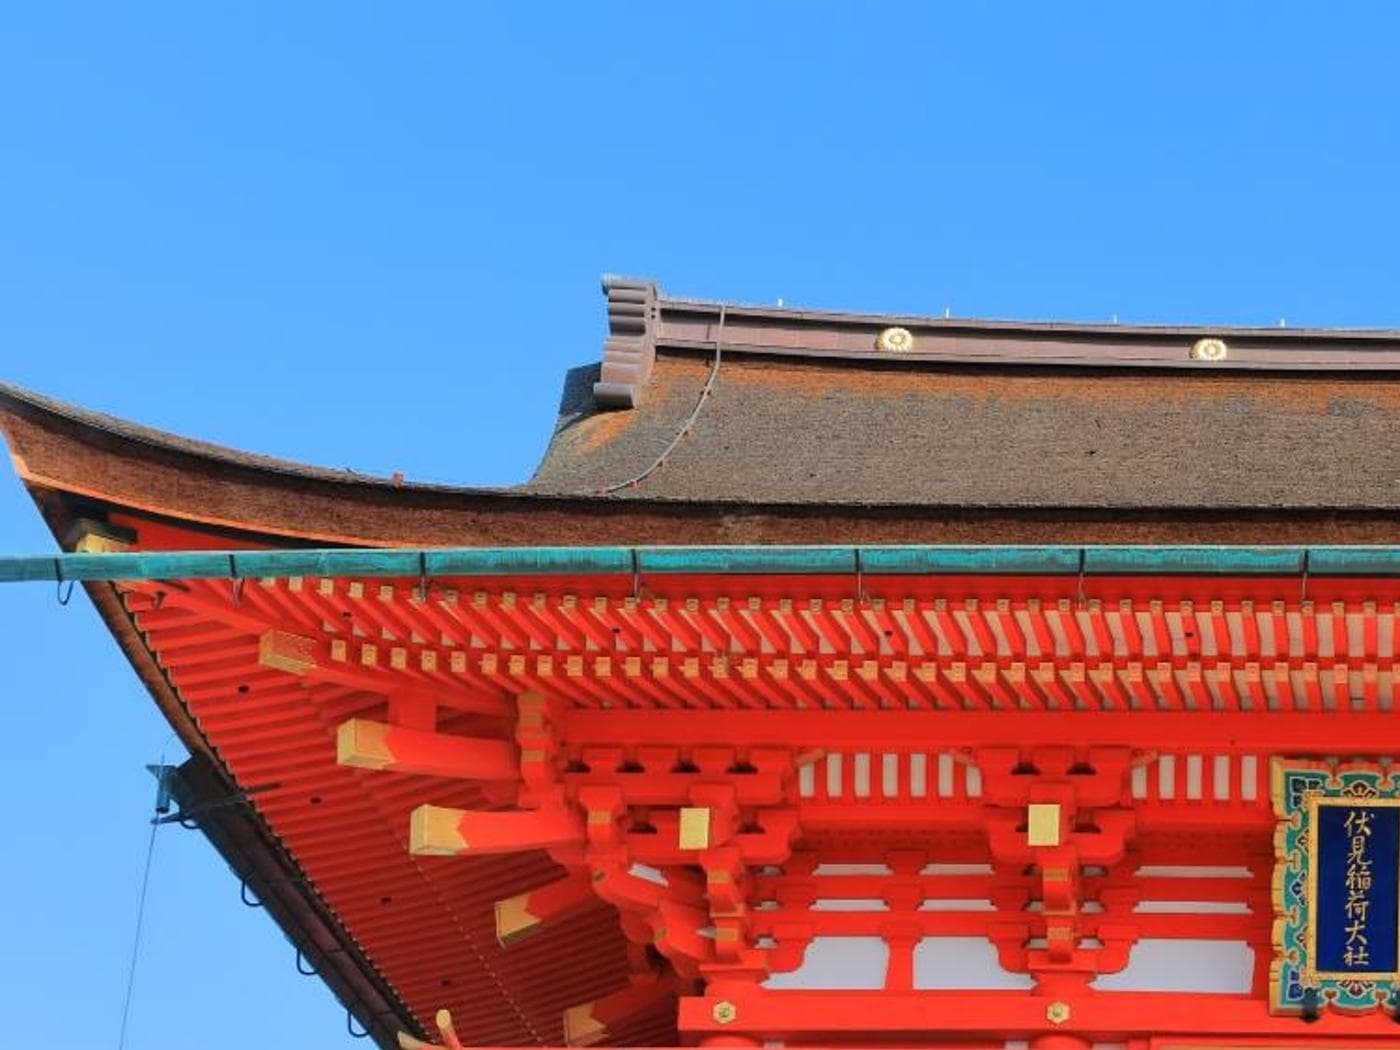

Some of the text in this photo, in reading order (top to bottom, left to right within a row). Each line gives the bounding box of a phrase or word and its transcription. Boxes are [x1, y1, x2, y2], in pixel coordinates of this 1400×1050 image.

[1343, 811, 1375, 966] 伏見稲荷大社
